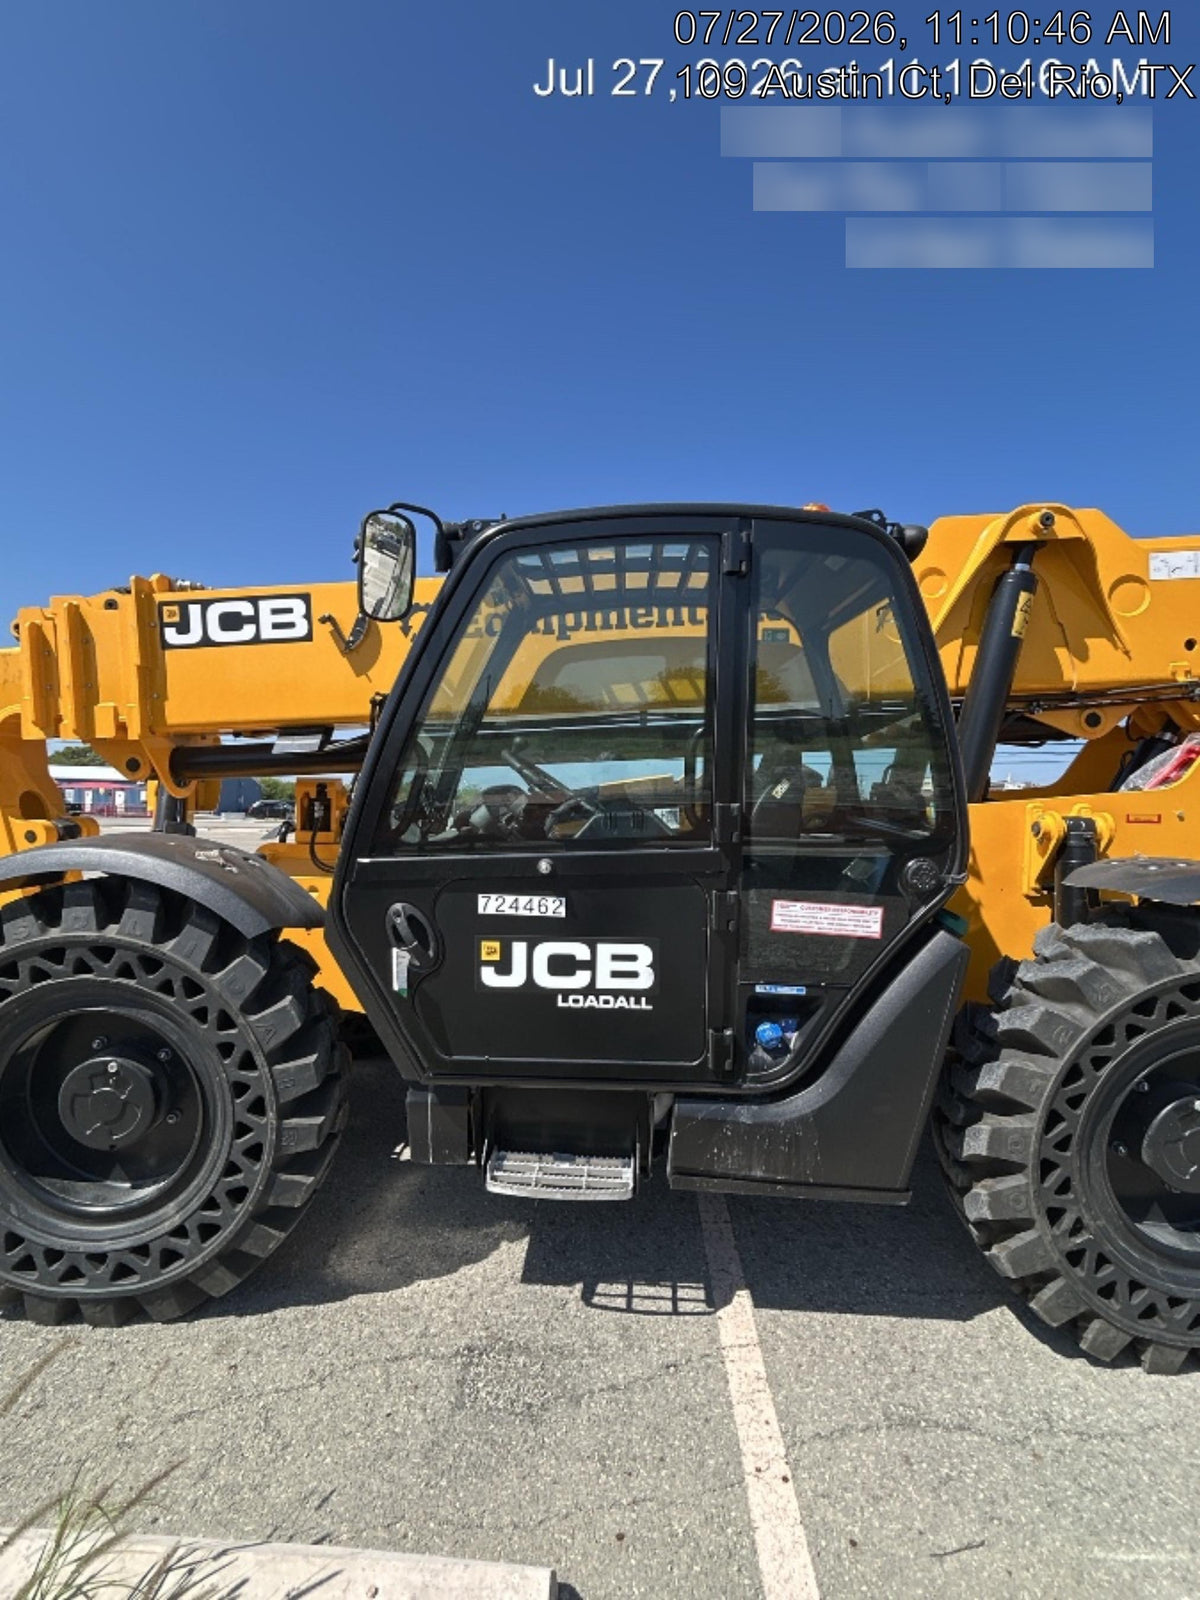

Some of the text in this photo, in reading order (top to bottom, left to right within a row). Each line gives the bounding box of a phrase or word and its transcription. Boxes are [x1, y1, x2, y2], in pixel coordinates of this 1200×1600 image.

[164, 598, 308, 645] JCB
[481, 895, 564, 915] 724462
[480, 941, 655, 990] JCB
[557, 994, 653, 1010] LOADALL
